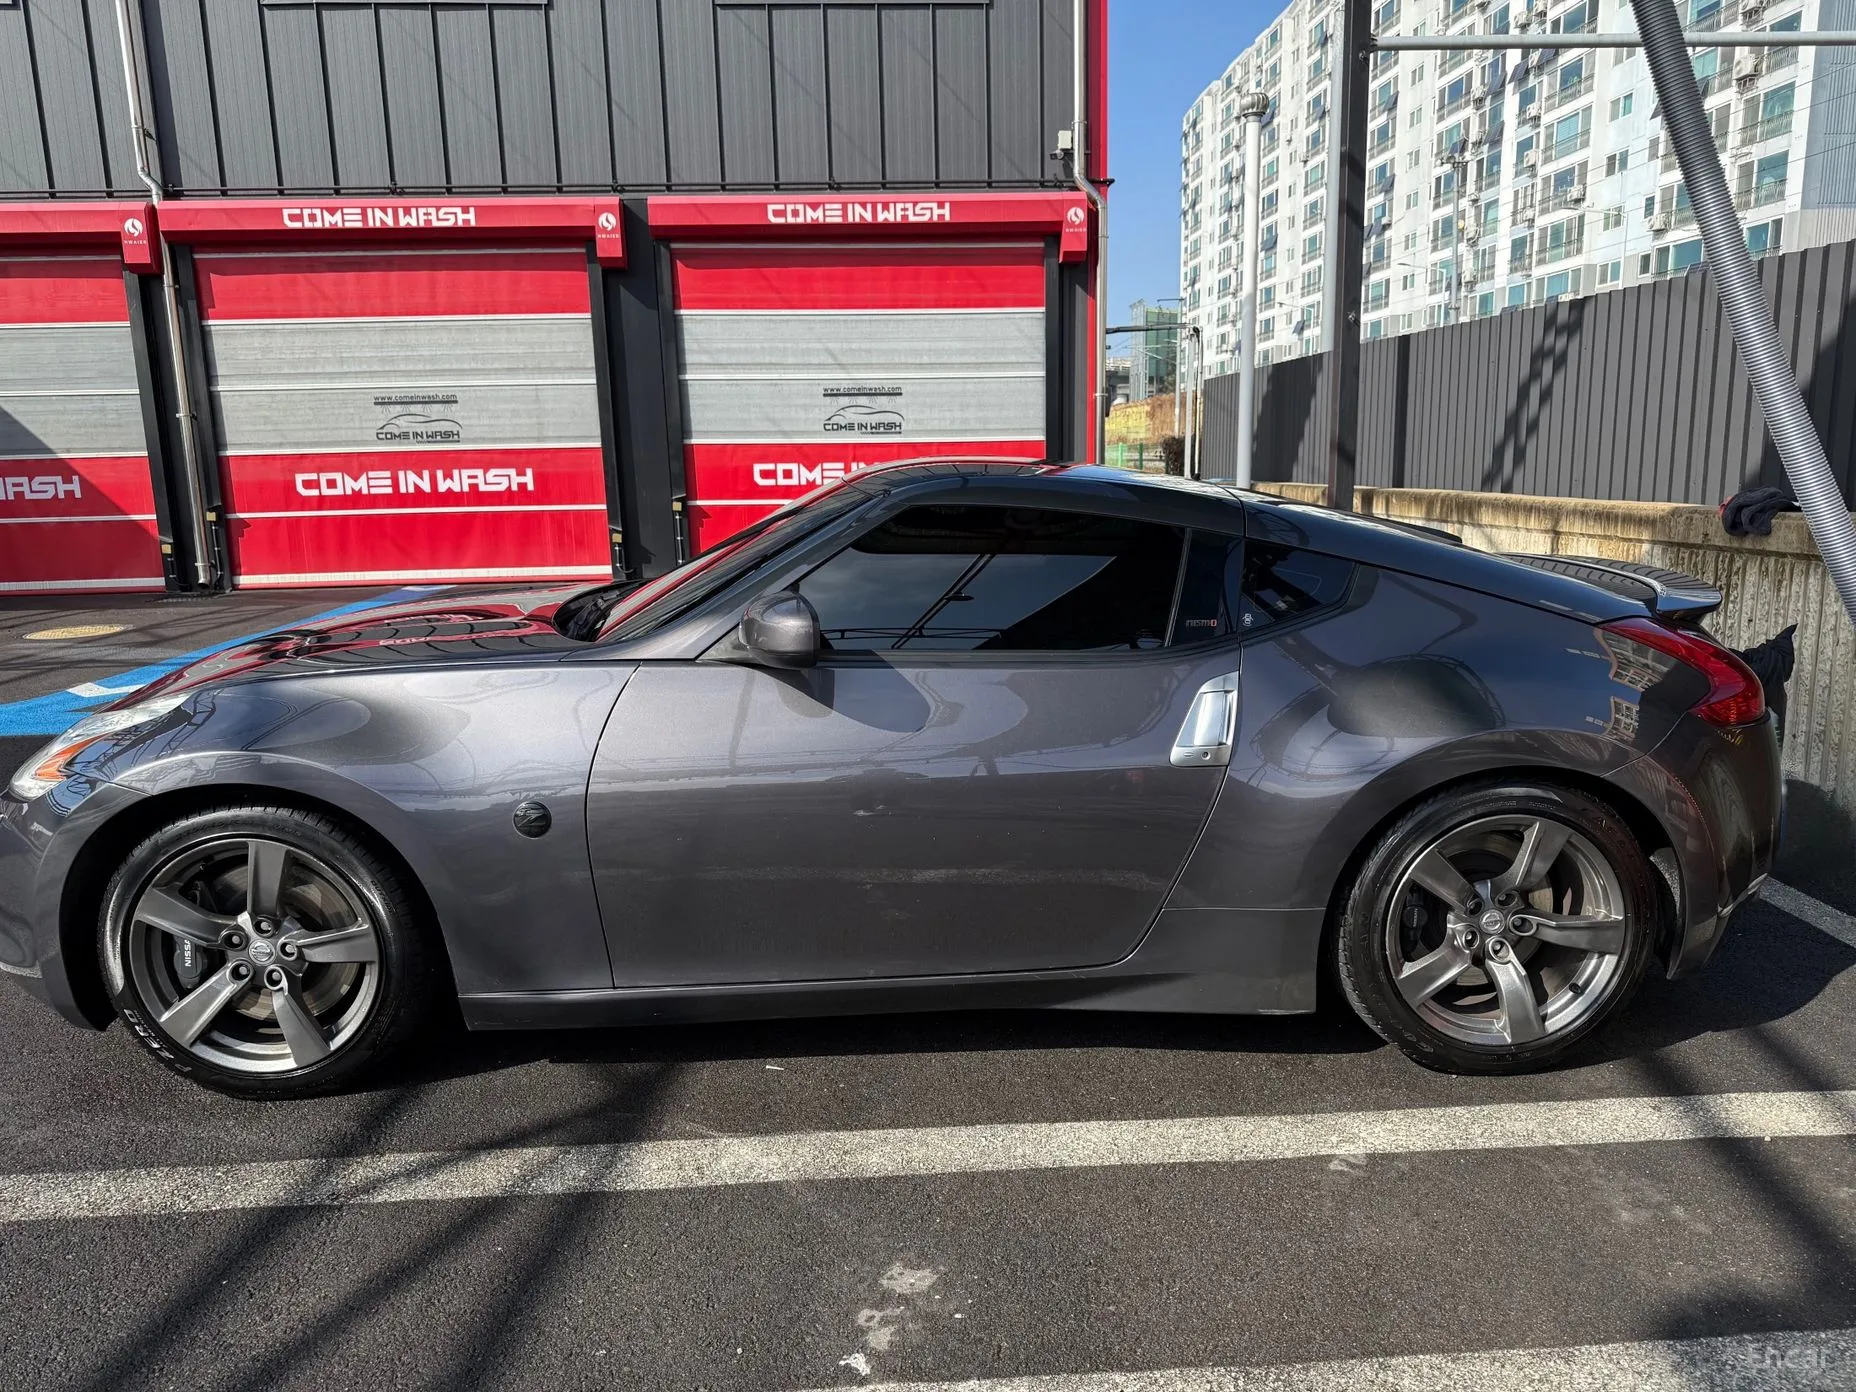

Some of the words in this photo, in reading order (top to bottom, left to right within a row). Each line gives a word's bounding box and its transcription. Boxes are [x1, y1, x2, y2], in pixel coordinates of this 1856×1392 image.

[282, 207, 363, 228] COME
[367, 207, 394, 227] IN
[398, 206, 476, 227] WASH
[767, 203, 843, 223] COME
[847, 202, 873, 222] IN
[877, 201, 951, 222] WASH
[373, 393, 458, 401] www.comeinwash.com
[823, 385, 903, 393] www.comeinwash.com
[376, 431, 411, 441] COME
[412, 431, 424, 440] IN
[426, 430, 460, 439] WASH
[823, 422, 856, 431] COME
[858, 422, 868, 431] IN
[870, 422, 902, 431] WASH
[294, 470, 393, 497] COME
[397, 469, 431, 494] IN
[436, 468, 535, 493] WASH
[753, 462, 845, 486] COME
[0, 475, 82, 500] ASH
[123, 1008, 175, 1060] ZERO
